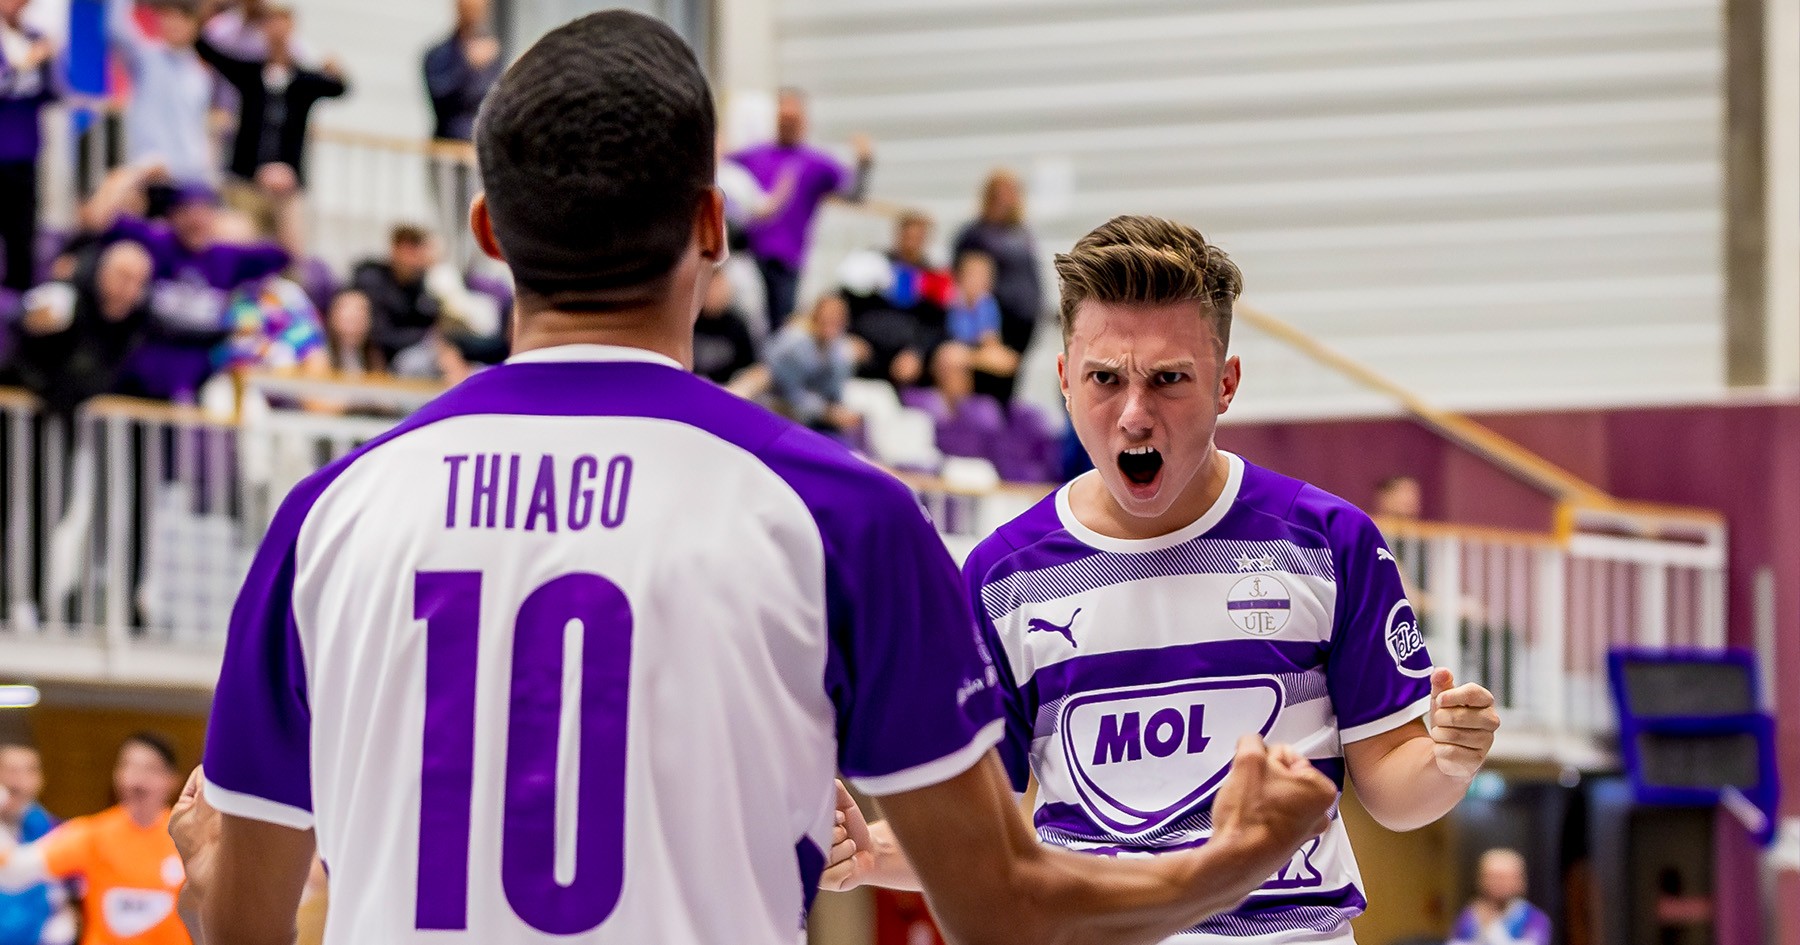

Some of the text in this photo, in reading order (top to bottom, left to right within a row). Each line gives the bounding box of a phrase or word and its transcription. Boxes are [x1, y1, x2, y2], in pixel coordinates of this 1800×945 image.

[443, 454, 633, 533] THIAGO
[1244, 611, 1277, 633] UTE
[413, 570, 634, 936] 10
[1091, 703, 1212, 766] MOL
